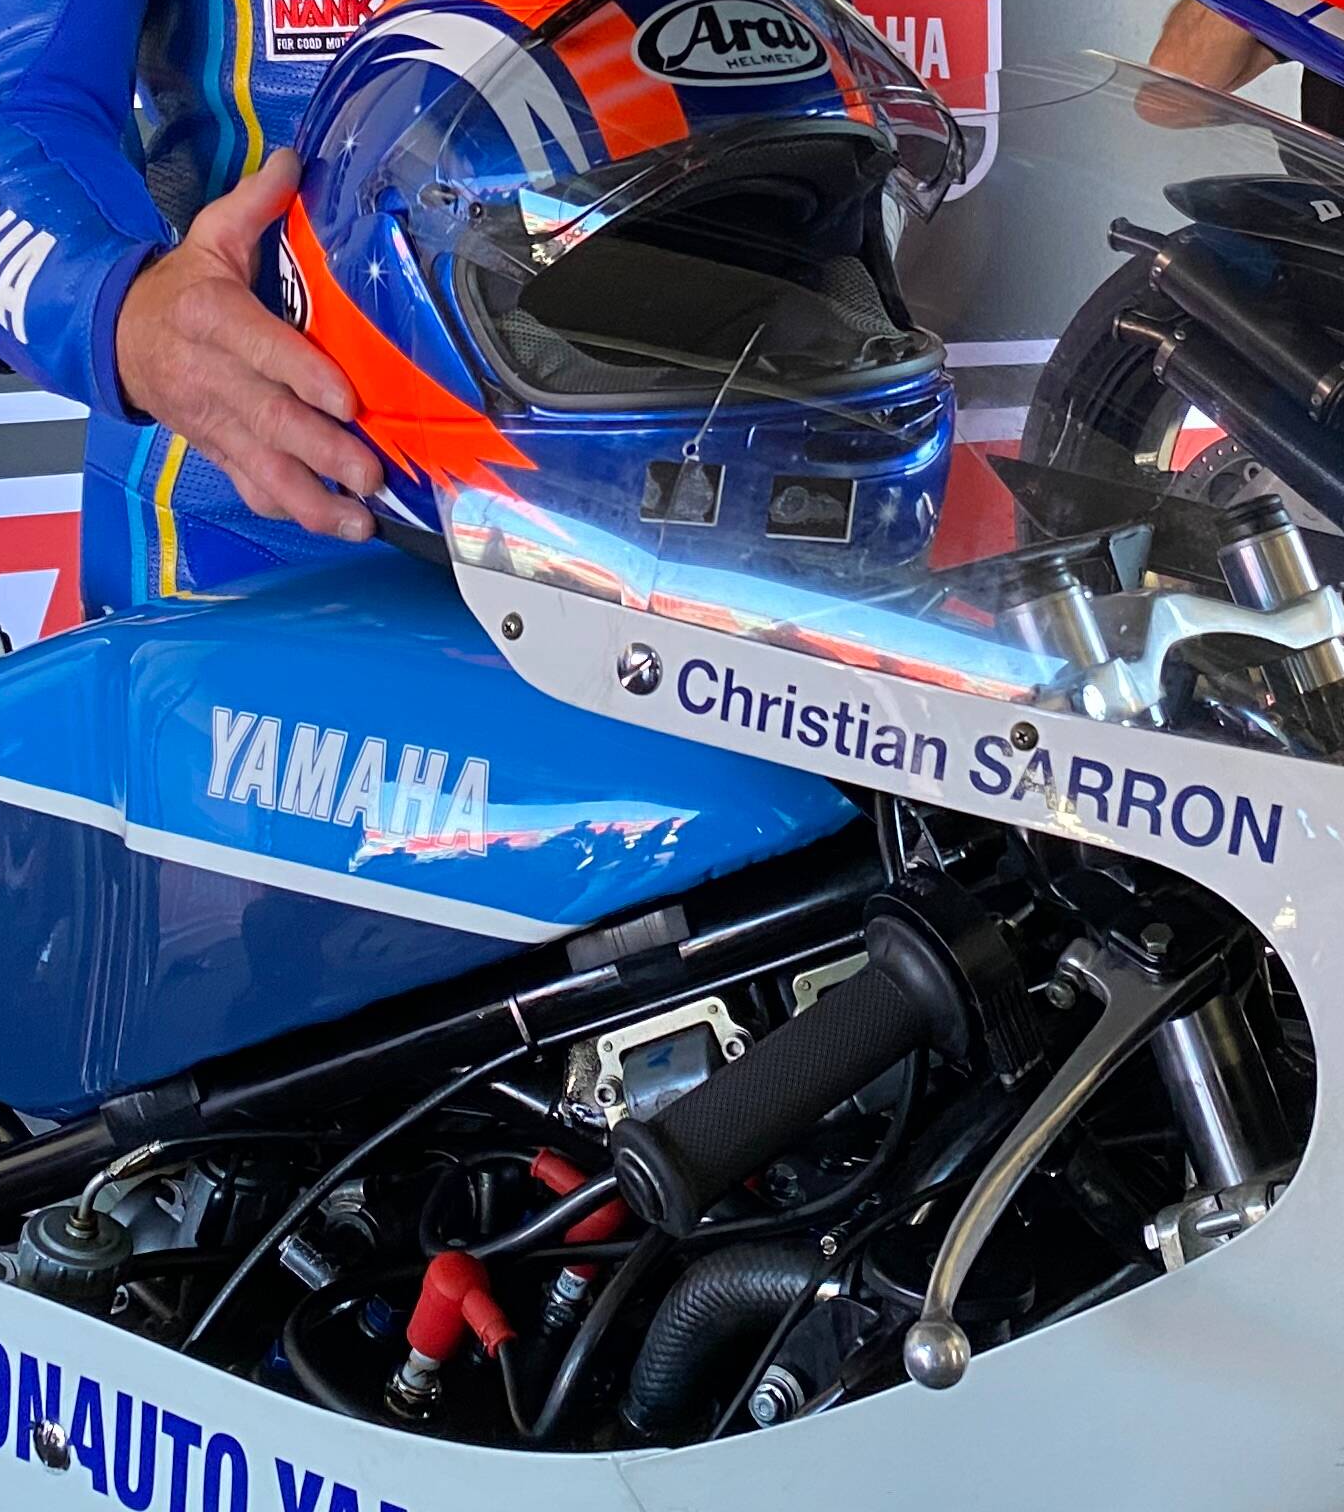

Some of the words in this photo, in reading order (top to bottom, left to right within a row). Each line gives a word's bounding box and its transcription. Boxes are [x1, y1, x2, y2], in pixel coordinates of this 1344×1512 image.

[277, 38, 294, 50] FOR
[664, 4, 811, 70] Arai
[726, 53, 796, 70] HELMET
[207, 705, 490, 857] YAMAHA
[676, 658, 947, 781] Christian
[969, 720, 1284, 864] SARRON
